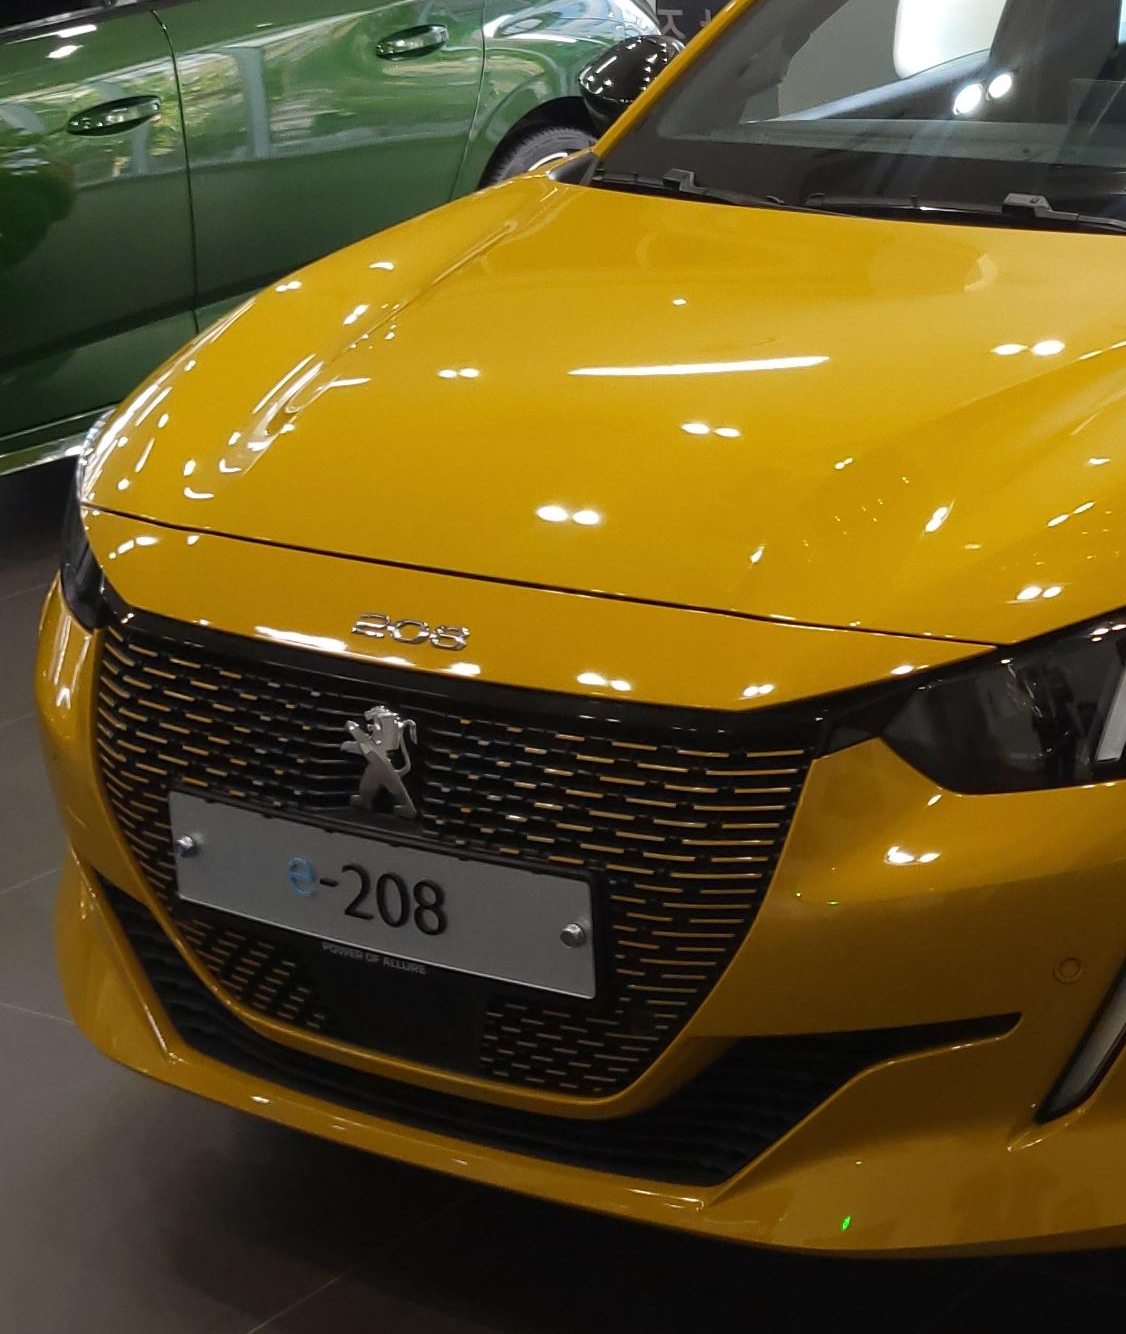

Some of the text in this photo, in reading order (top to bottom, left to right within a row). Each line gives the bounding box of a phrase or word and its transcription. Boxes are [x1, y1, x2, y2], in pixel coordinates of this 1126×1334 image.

[352, 612, 470, 651] 208
[288, 856, 448, 936] e-208
[321, 941, 427, 975] POWER OF ALLURE
